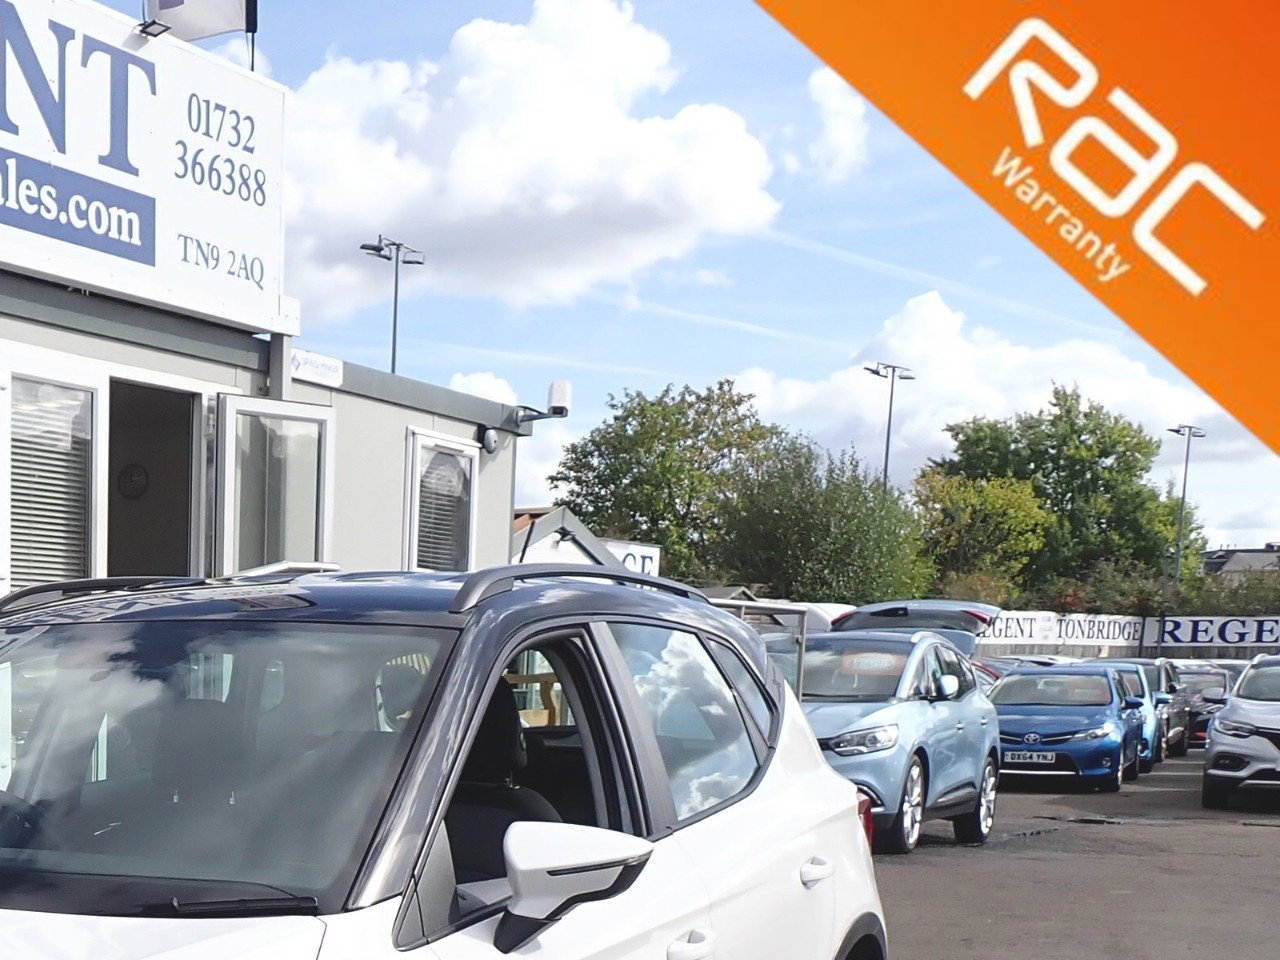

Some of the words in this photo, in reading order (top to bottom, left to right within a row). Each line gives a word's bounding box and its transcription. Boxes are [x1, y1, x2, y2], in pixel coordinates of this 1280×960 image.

[187, 93, 256, 154] 01732
[174, 140, 267, 207] 366388
[177, 233, 220, 271] TN9
[227, 250, 265, 290] 2AQ
[1057, 618, 1142, 641] TONBRIDGE
